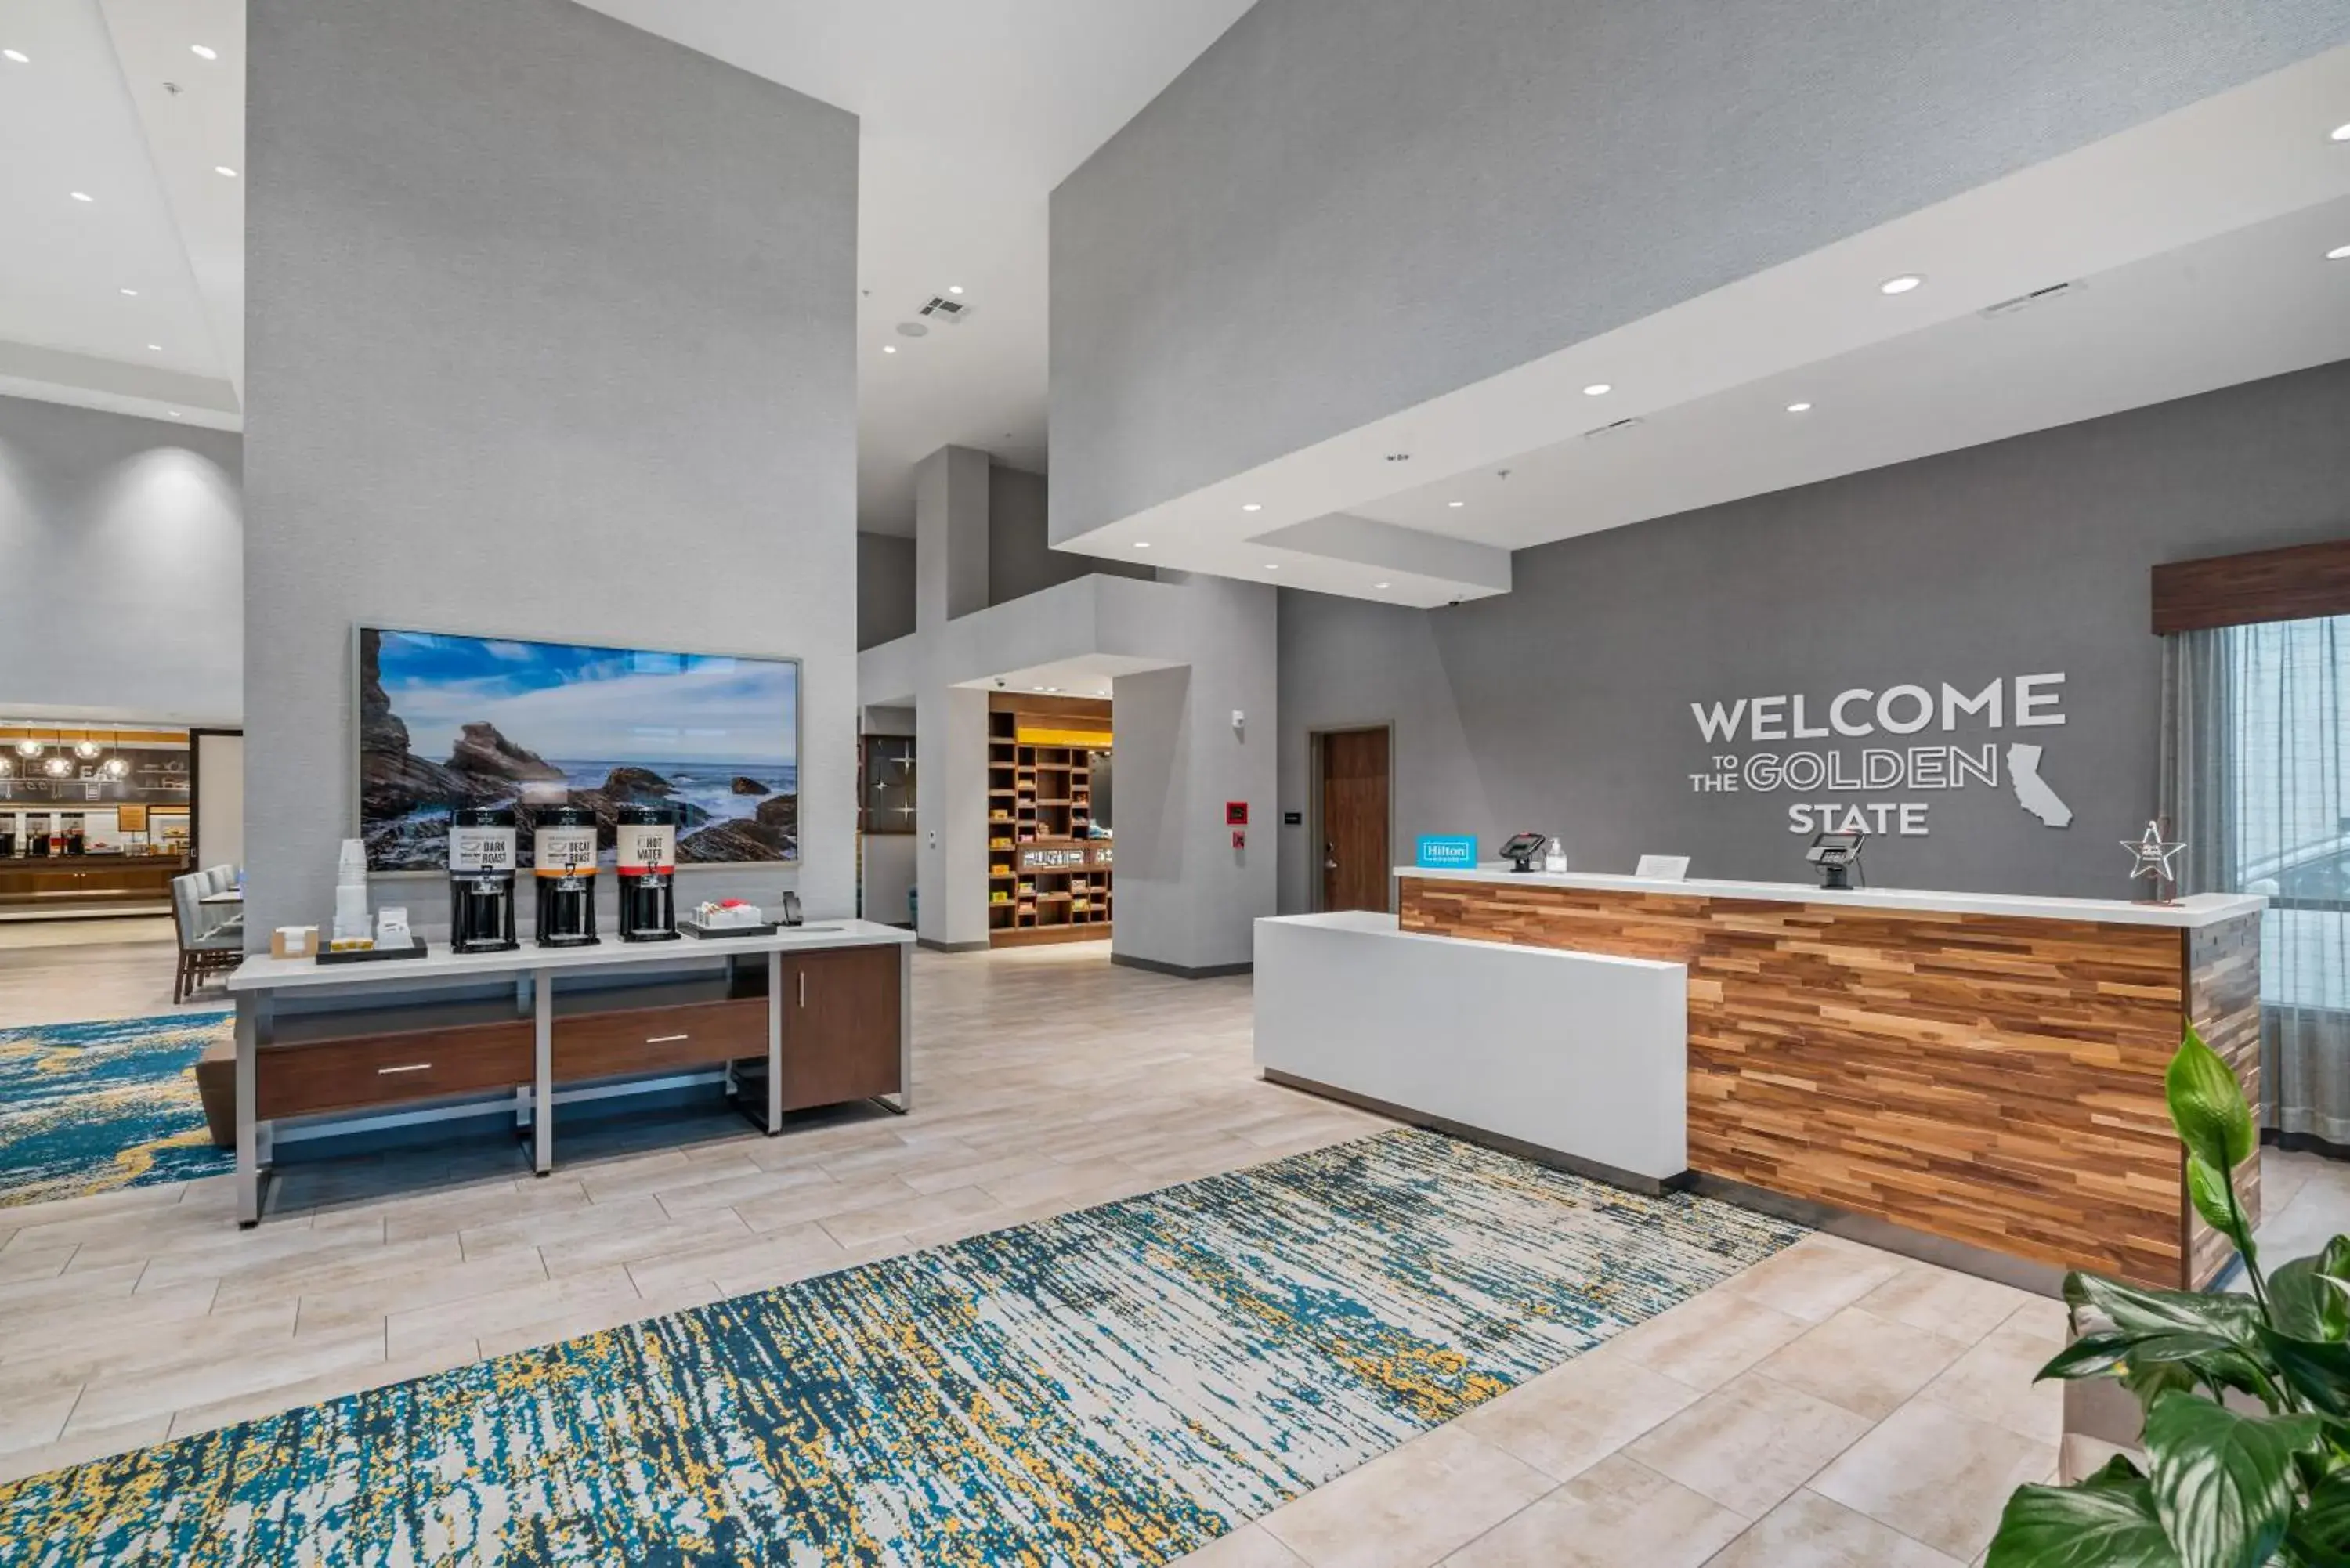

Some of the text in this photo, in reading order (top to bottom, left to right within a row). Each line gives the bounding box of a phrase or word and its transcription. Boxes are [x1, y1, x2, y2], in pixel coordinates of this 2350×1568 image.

[1690, 672, 2066, 743] WELCOME
[1689, 743, 1998, 792] THE GOLDEN
[1712, 754, 1738, 769] TO
[1788, 802, 1929, 835] STATE
[483, 840, 505, 852] DARK
[1428, 845, 1465, 856] Hilton
[637, 848, 663, 860] WATER
